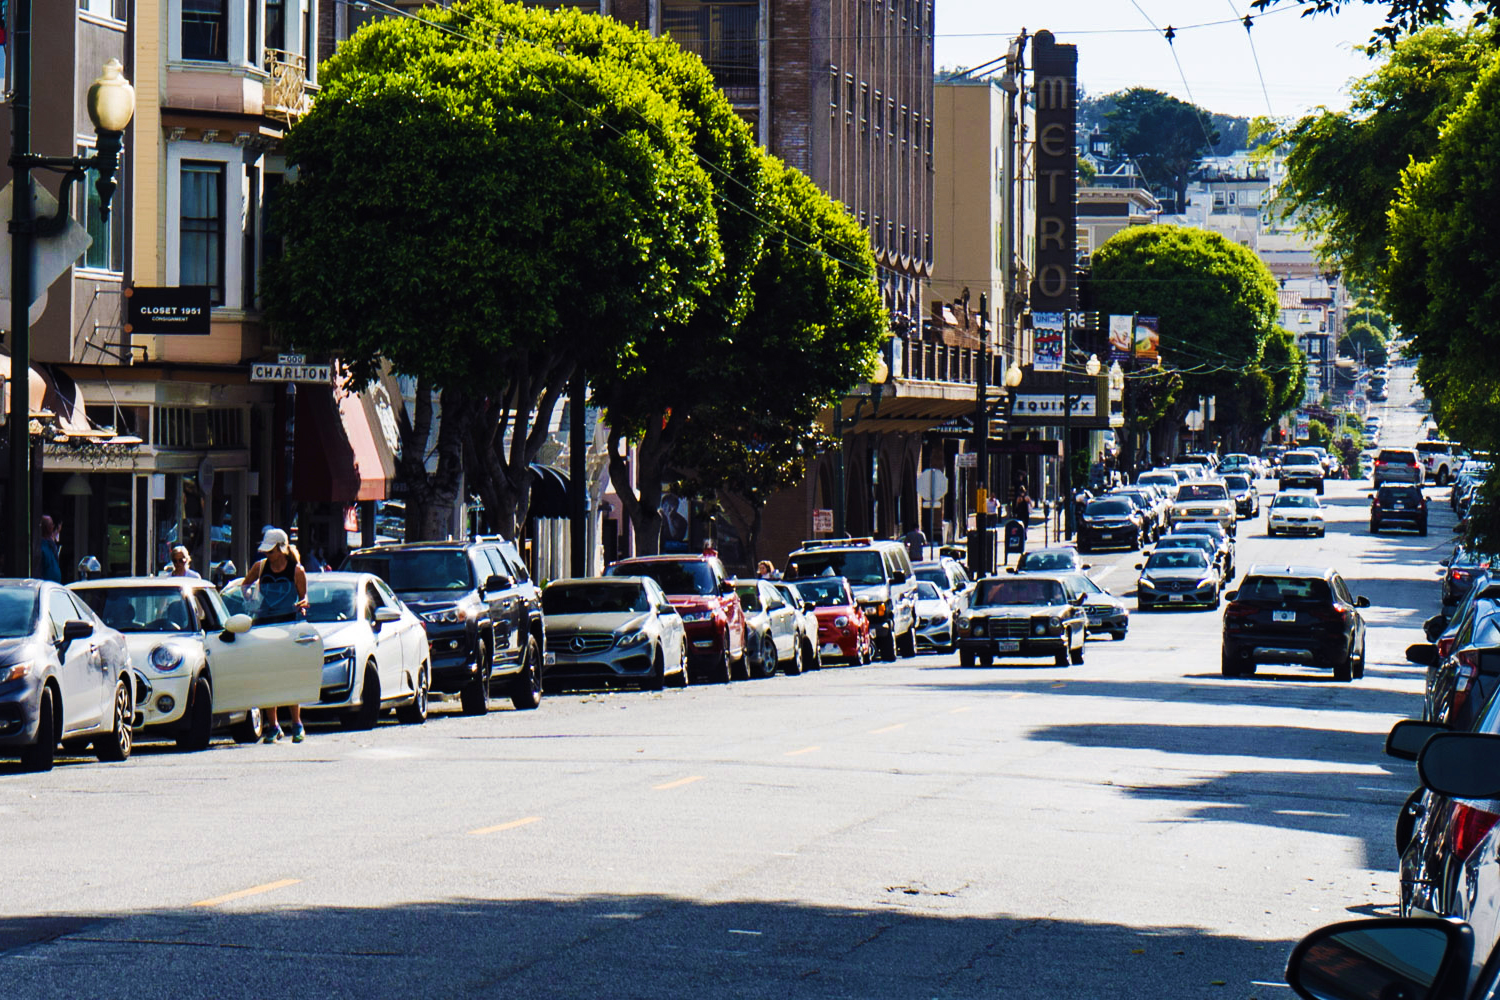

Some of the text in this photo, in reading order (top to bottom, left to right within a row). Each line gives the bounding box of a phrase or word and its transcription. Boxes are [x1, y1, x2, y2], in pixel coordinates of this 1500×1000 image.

[140, 307, 202, 315] CLOSET 1951
[256, 367, 328, 380] CHARLTON
[1017, 401, 1090, 410] EQUINOX
